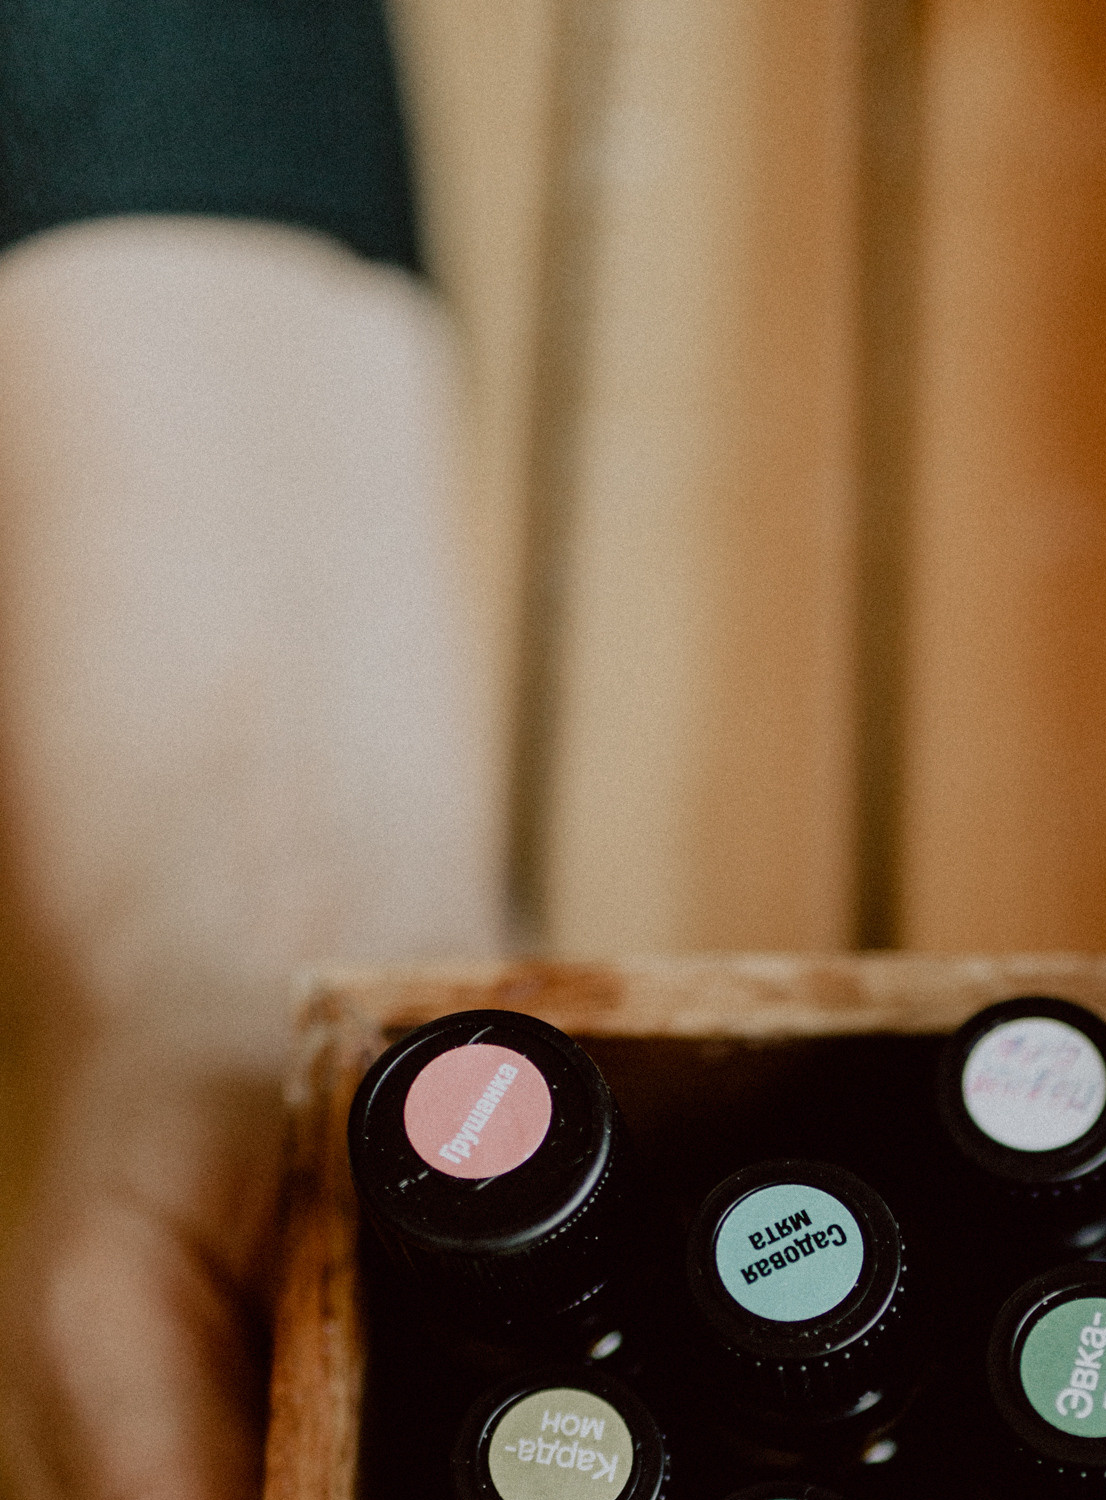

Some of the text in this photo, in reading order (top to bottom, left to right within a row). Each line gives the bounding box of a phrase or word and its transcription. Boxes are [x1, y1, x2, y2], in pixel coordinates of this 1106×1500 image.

[438, 1062, 519, 1165] Грушанка
[748, 1208, 813, 1251] мята
[740, 1223, 848, 1285] Садовая
[541, 1409, 606, 1441] мон
[504, 1436, 619, 1483] Карда-
